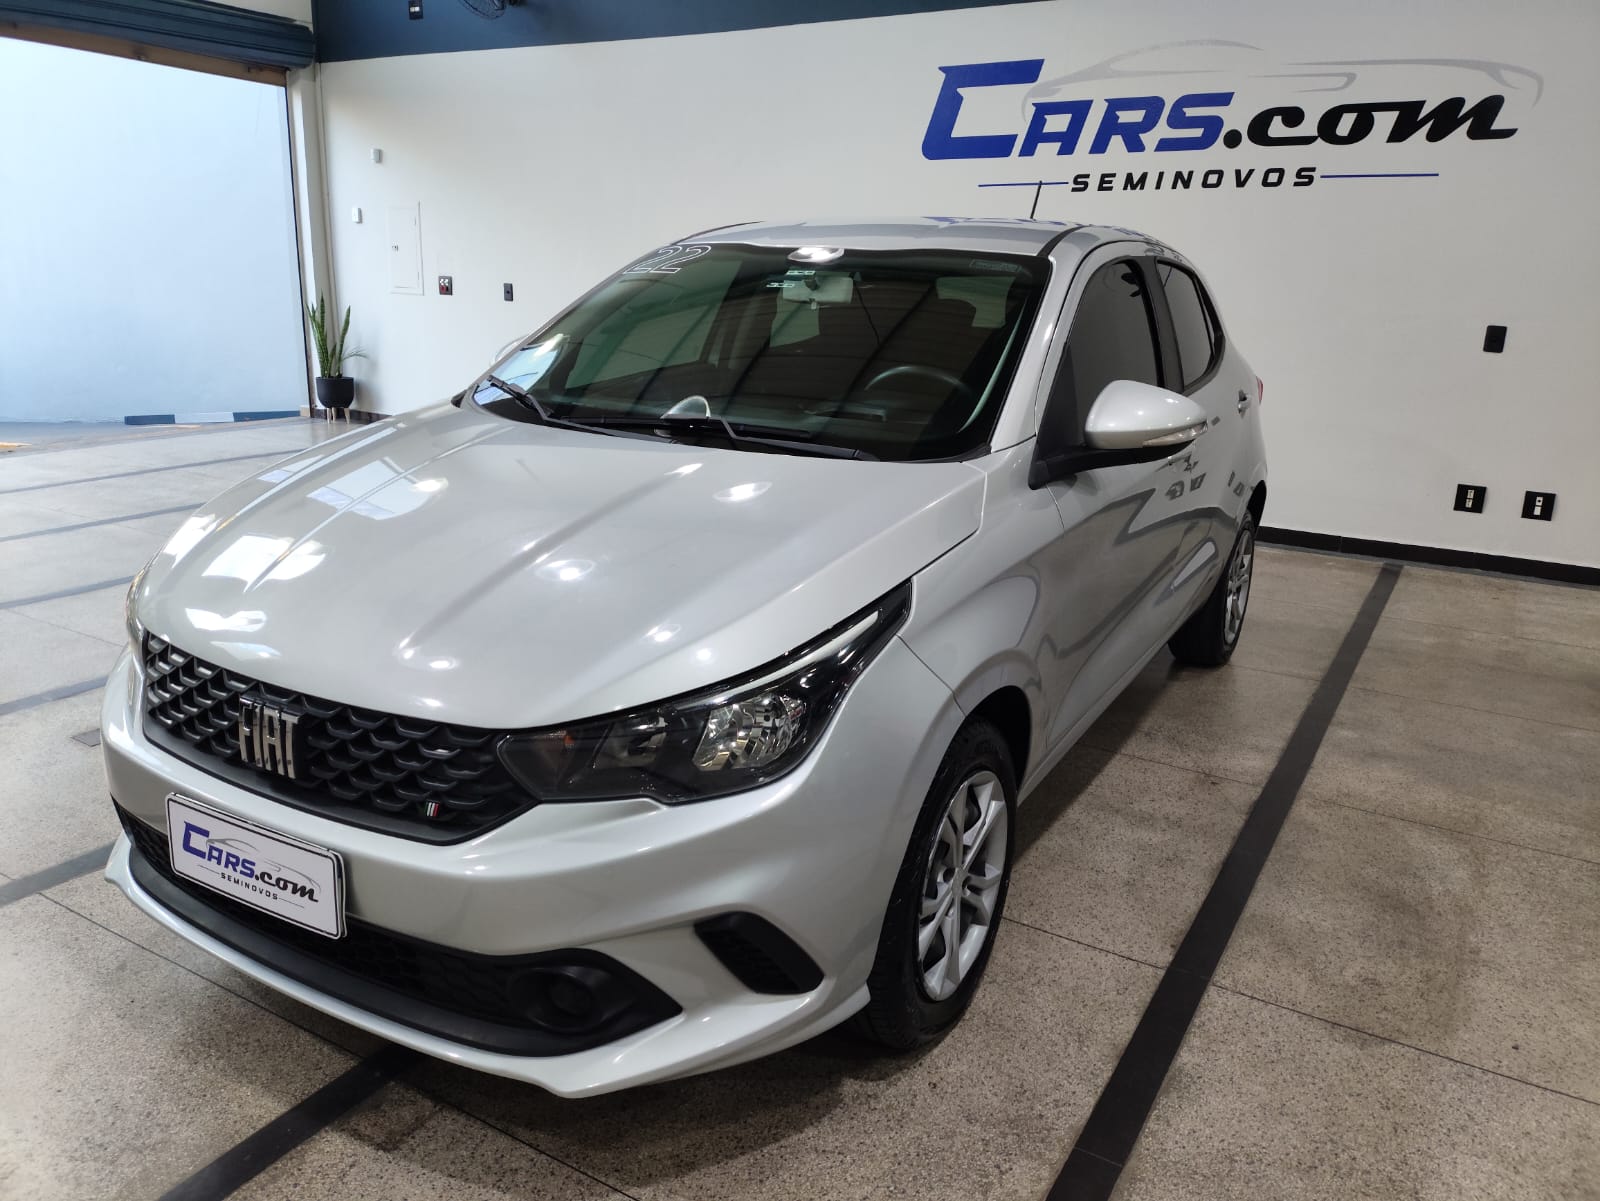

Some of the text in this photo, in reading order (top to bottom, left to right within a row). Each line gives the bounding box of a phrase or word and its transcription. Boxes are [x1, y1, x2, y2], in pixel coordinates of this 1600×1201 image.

[921, 59, 1519, 160] CARS.com
[1071, 167, 1317, 192] SEMINOVOS
[622, 245, 712, 274] 22
[239, 698, 299, 779] FIAT
[182, 821, 319, 902] CARS.com
[221, 872, 278, 900] SEMINOVOS
